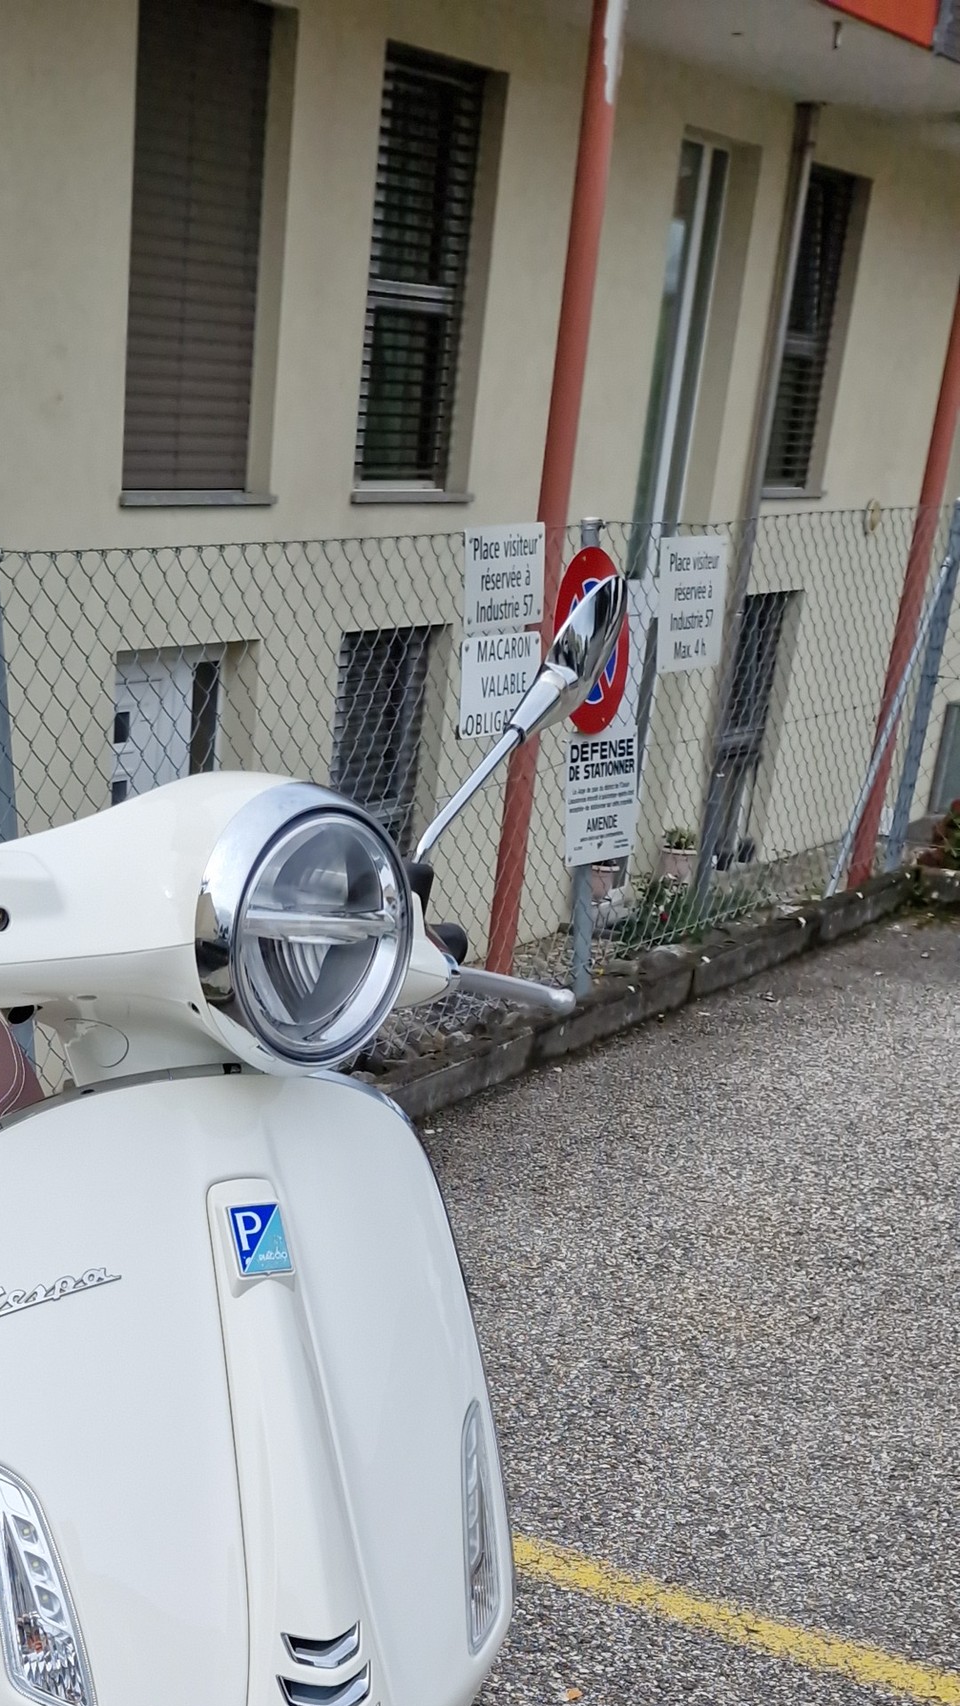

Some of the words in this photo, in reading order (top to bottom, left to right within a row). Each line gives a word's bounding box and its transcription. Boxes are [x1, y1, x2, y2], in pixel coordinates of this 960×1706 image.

[473, 535, 500, 561] Place
[503, 533, 538, 558] visiteur
[669, 552, 691, 572] Place
[692, 551, 720, 571] visiteur
[480, 564, 522, 592] réservée
[525, 563, 531, 586] à
[673, 581, 706, 602] réservée
[707, 580, 713, 599] à
[475, 595, 520, 623] Industrie
[523, 593, 534, 616] 57
[669, 609, 703, 632] Industrie
[705, 608, 714, 628] 57
[477, 635, 531, 663] MACARON
[694, 638, 700, 656] 4
[481, 671, 527, 698] VALABLE
[568, 765, 580, 782] DE
[583, 758, 635, 780] STATIONNER
[586, 814, 618, 833] AMENDE
[234, 1211, 262, 1251] P
